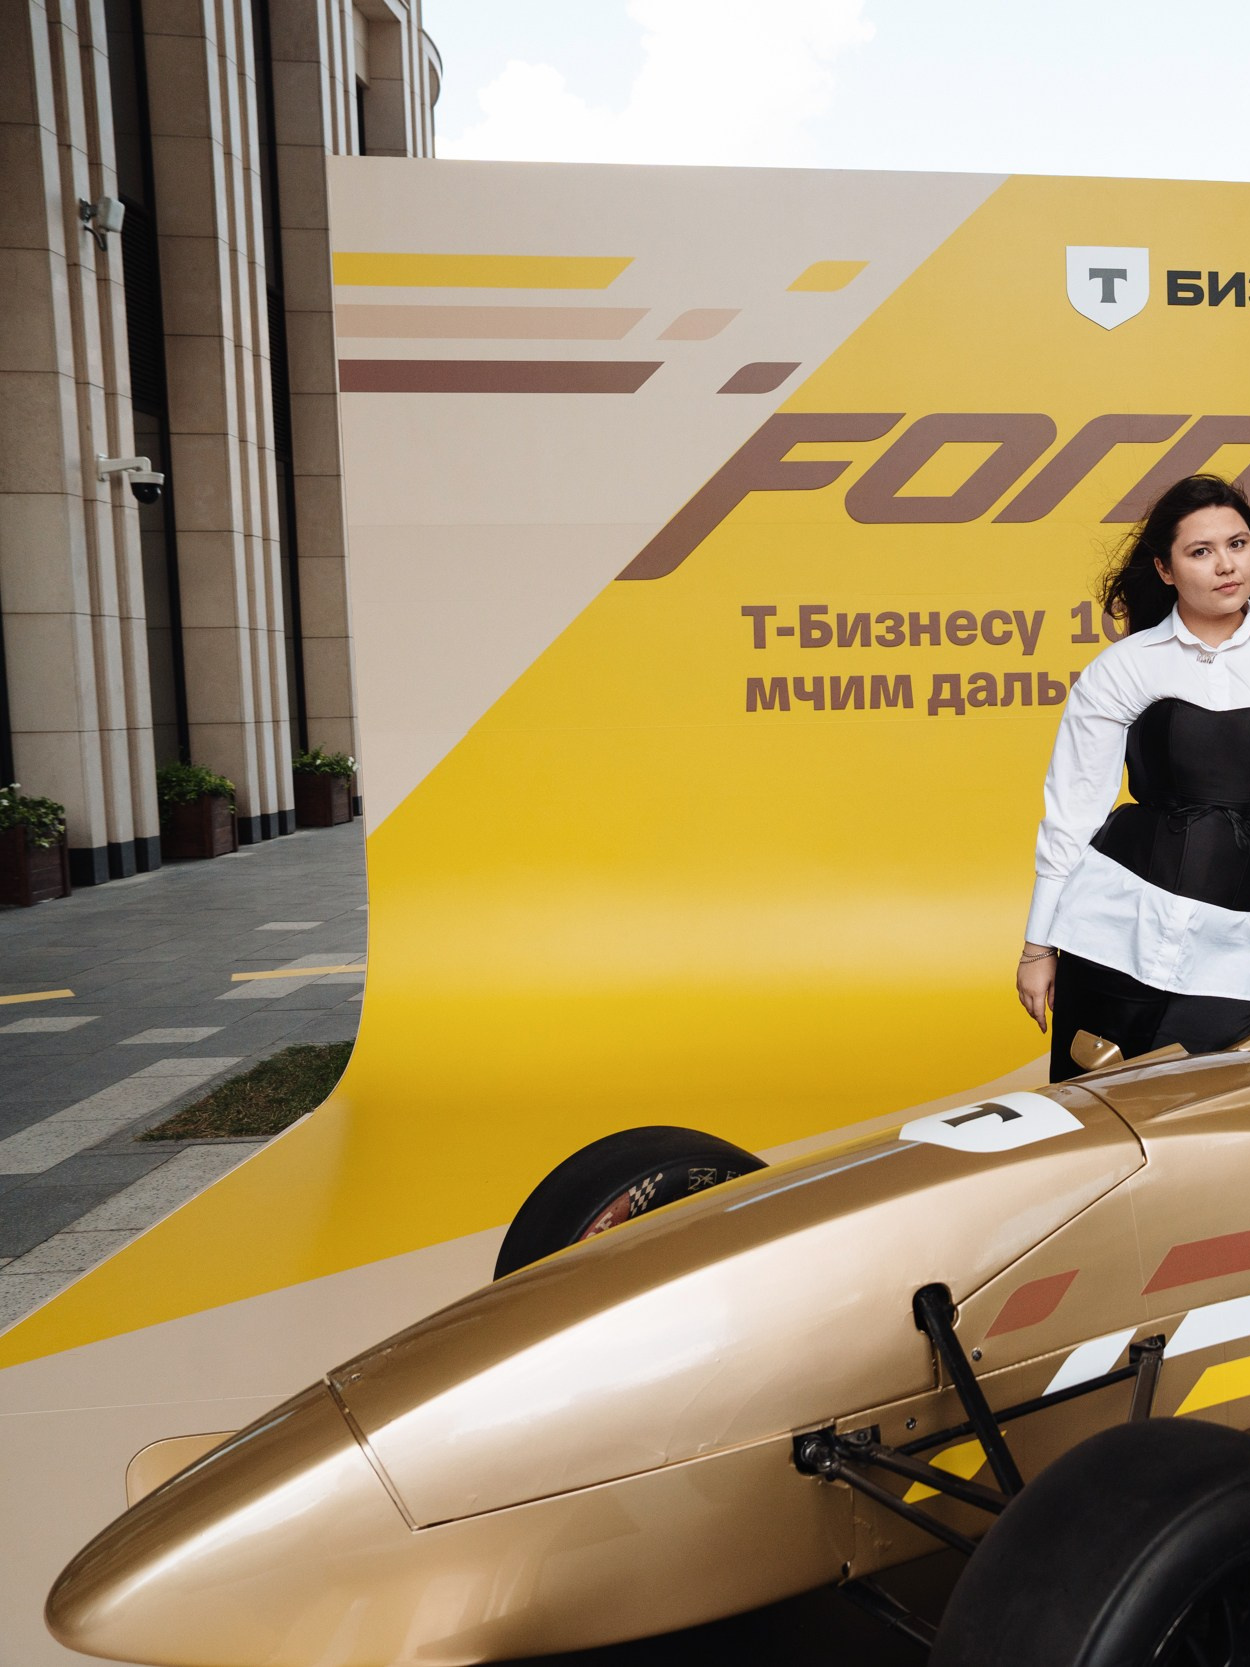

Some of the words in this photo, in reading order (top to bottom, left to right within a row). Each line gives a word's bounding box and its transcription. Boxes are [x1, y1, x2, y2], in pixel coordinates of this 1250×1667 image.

[741, 604, 1046, 656] Т-Бизнесу
[745, 673, 912, 713] мчим
[927, 670, 1081, 716] даль
